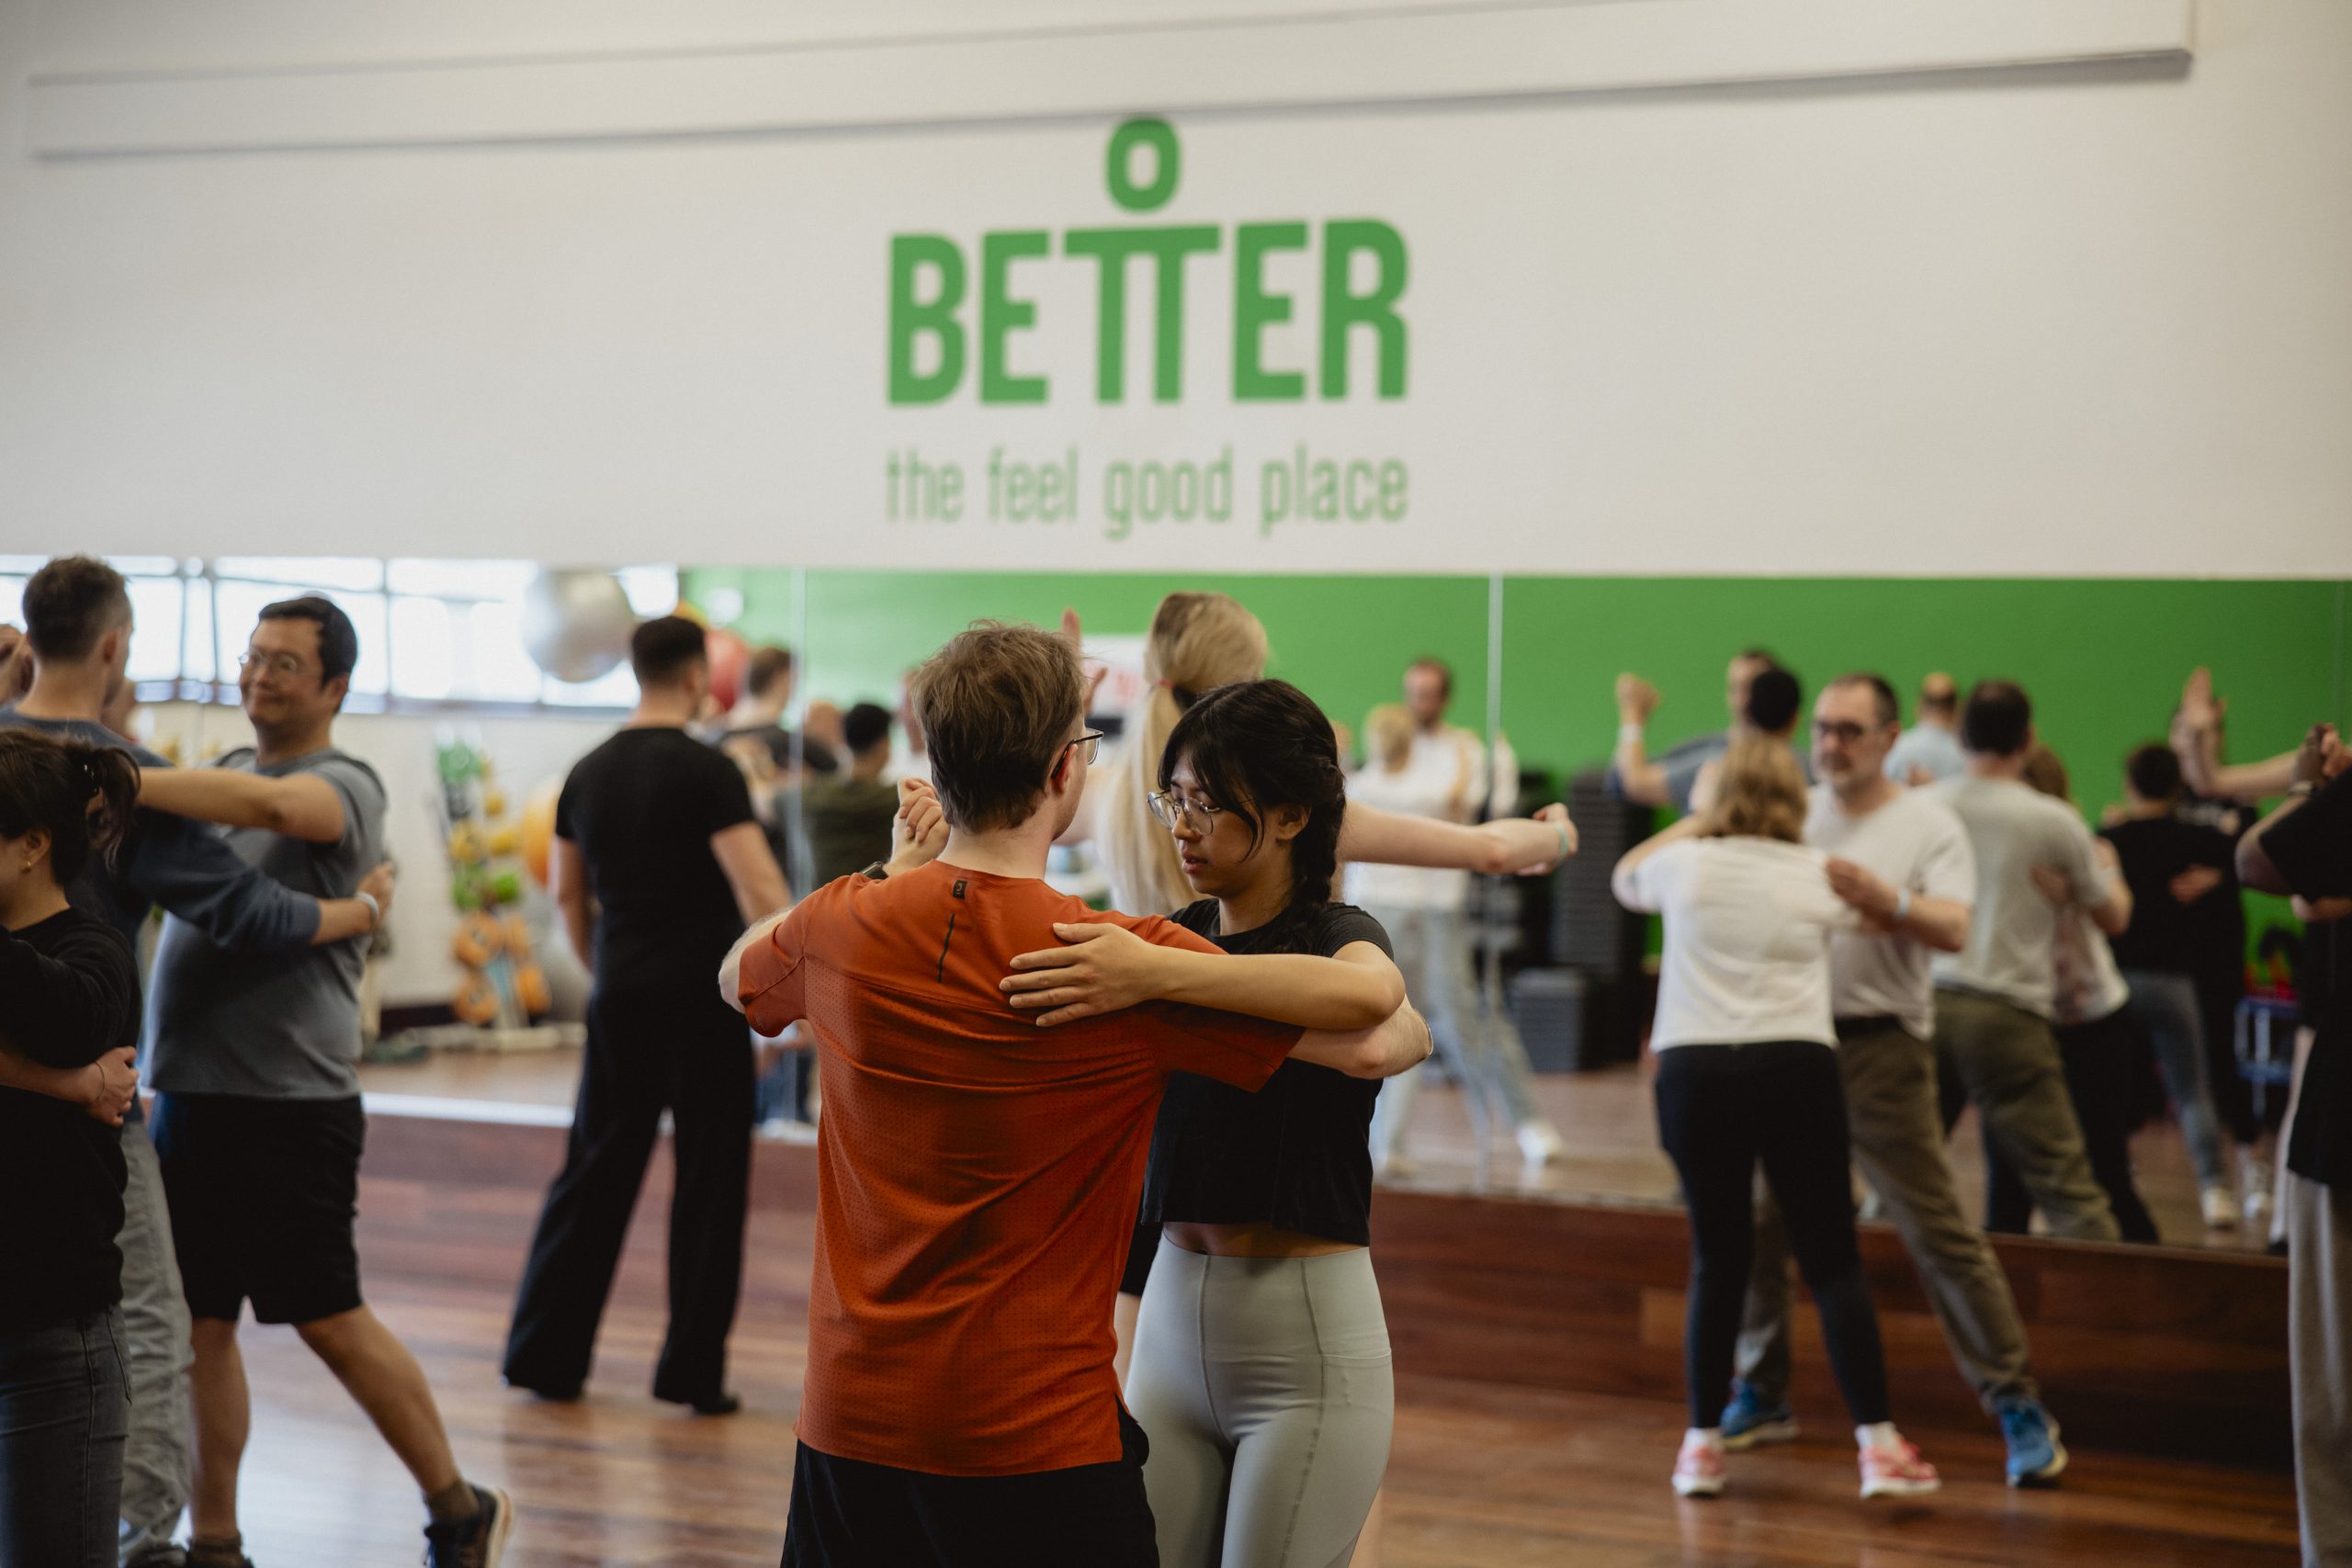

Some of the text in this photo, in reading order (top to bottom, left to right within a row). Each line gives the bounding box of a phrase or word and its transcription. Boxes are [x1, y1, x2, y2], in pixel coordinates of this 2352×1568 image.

[888, 219, 1408, 406] BETTER
[887, 443, 1409, 542] the feel good place
